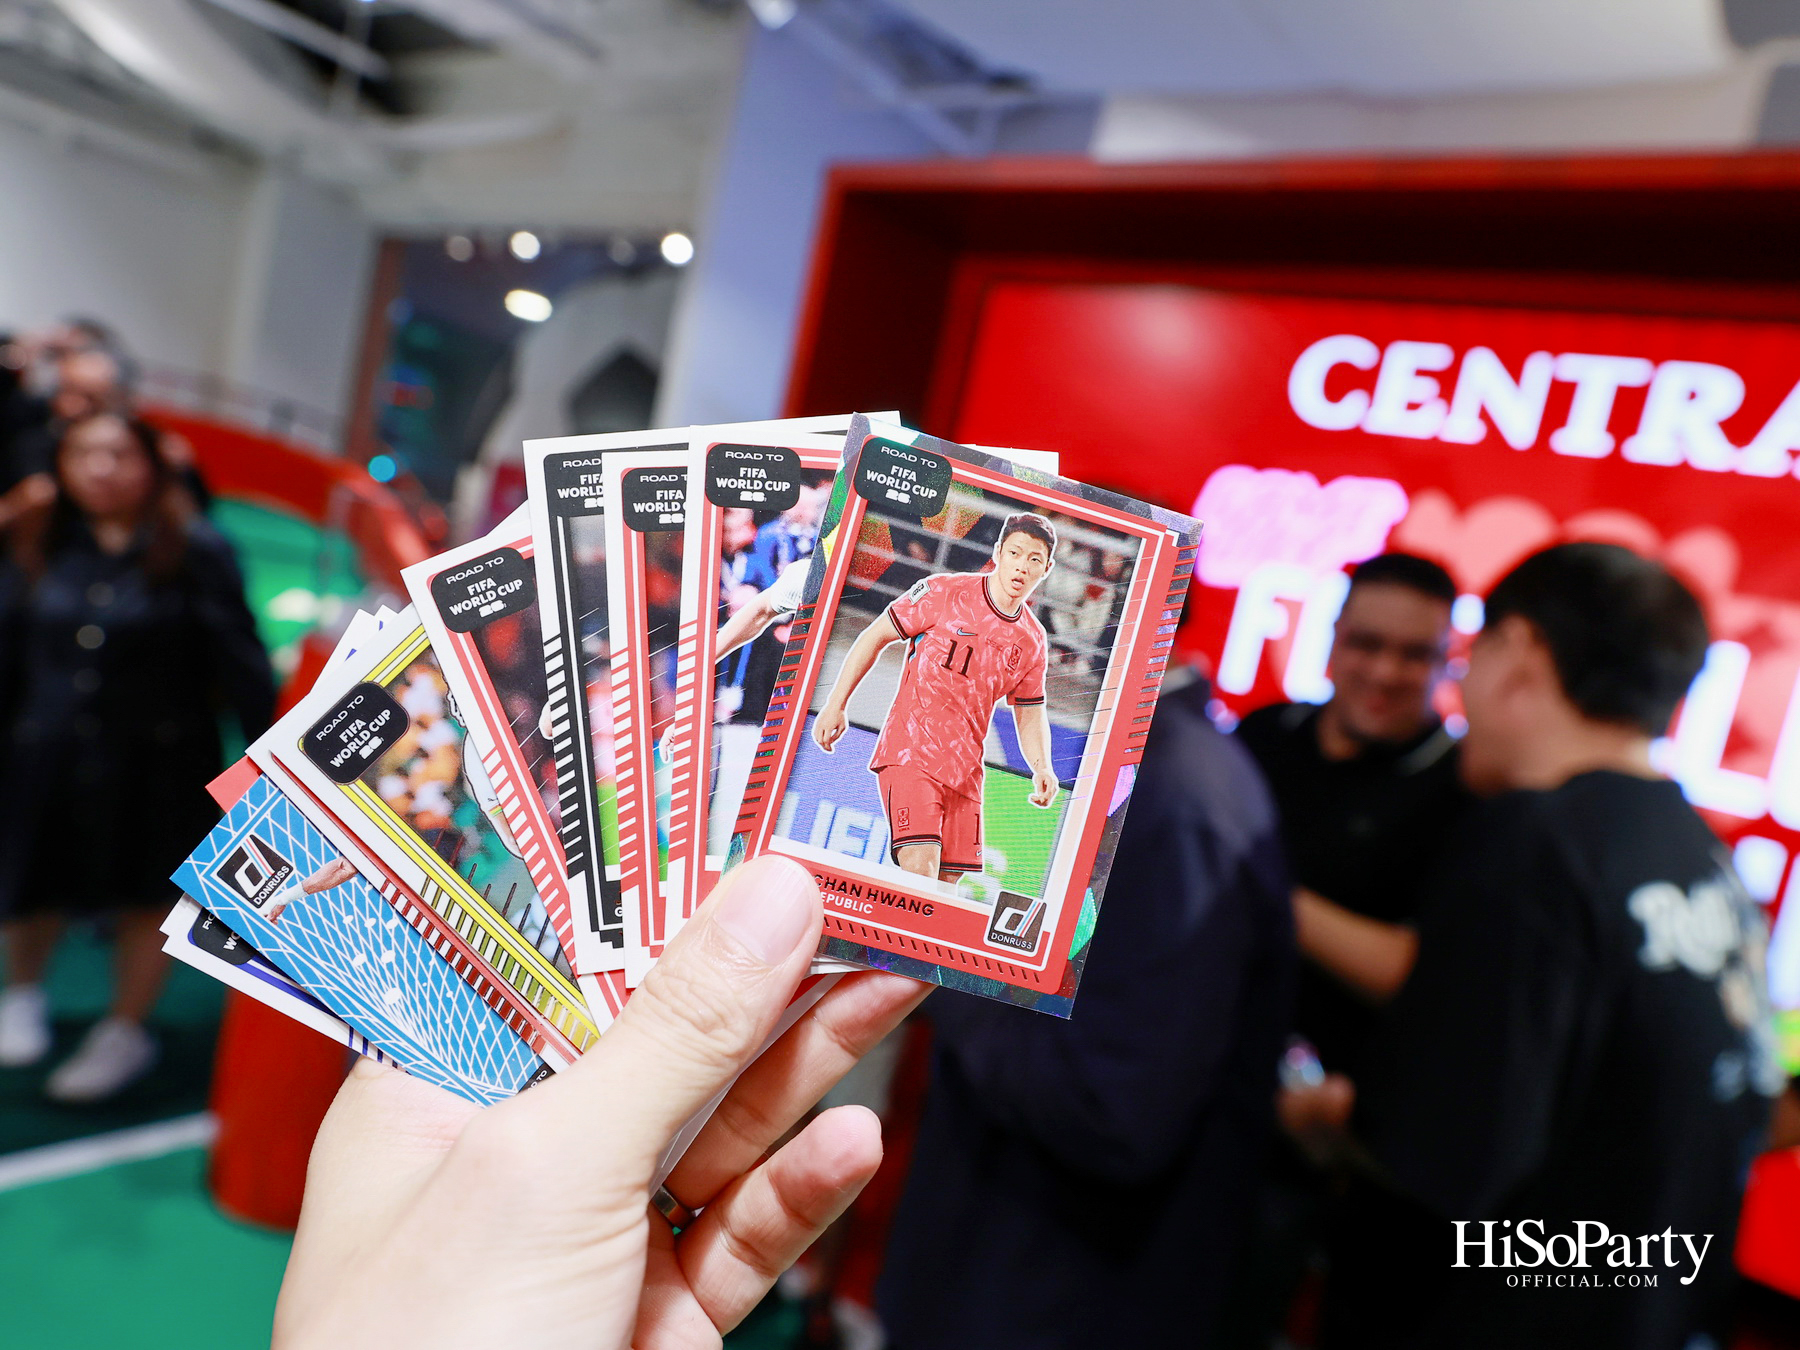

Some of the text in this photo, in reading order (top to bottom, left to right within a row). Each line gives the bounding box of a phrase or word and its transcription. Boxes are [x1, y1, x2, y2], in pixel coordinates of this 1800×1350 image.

[562, 458, 602, 468] ROAD
[725, 451, 784, 462] ROAD TO
[881, 445, 938, 469] ROAD TO
[640, 474, 678, 482] ROAD
[739, 467, 767, 479] FIFA
[890, 464, 917, 482] FIFA
[557, 485, 604, 499] WORLD
[656, 489, 684, 500] FIFA
[715, 477, 791, 492] WORLD CUP
[866, 469, 938, 499] WORLD CUP
[633, 501, 681, 513] WORLD
[445, 556, 504, 585] ROAD TO
[466, 577, 497, 596] FIFA
[449, 579, 523, 616] WORLD CUP
[941, 639, 973, 678] 11
[316, 695, 364, 741] ROAD TO
[329, 709, 391, 768] WORLD CUP
[339, 718, 367, 743] FIFA
[253, 865, 290, 905] DONRUSS
[814, 873, 935, 917] CHAN HWANG
[820, 891, 874, 914] EPUBLIC
[991, 932, 1033, 949] DONRUSS
